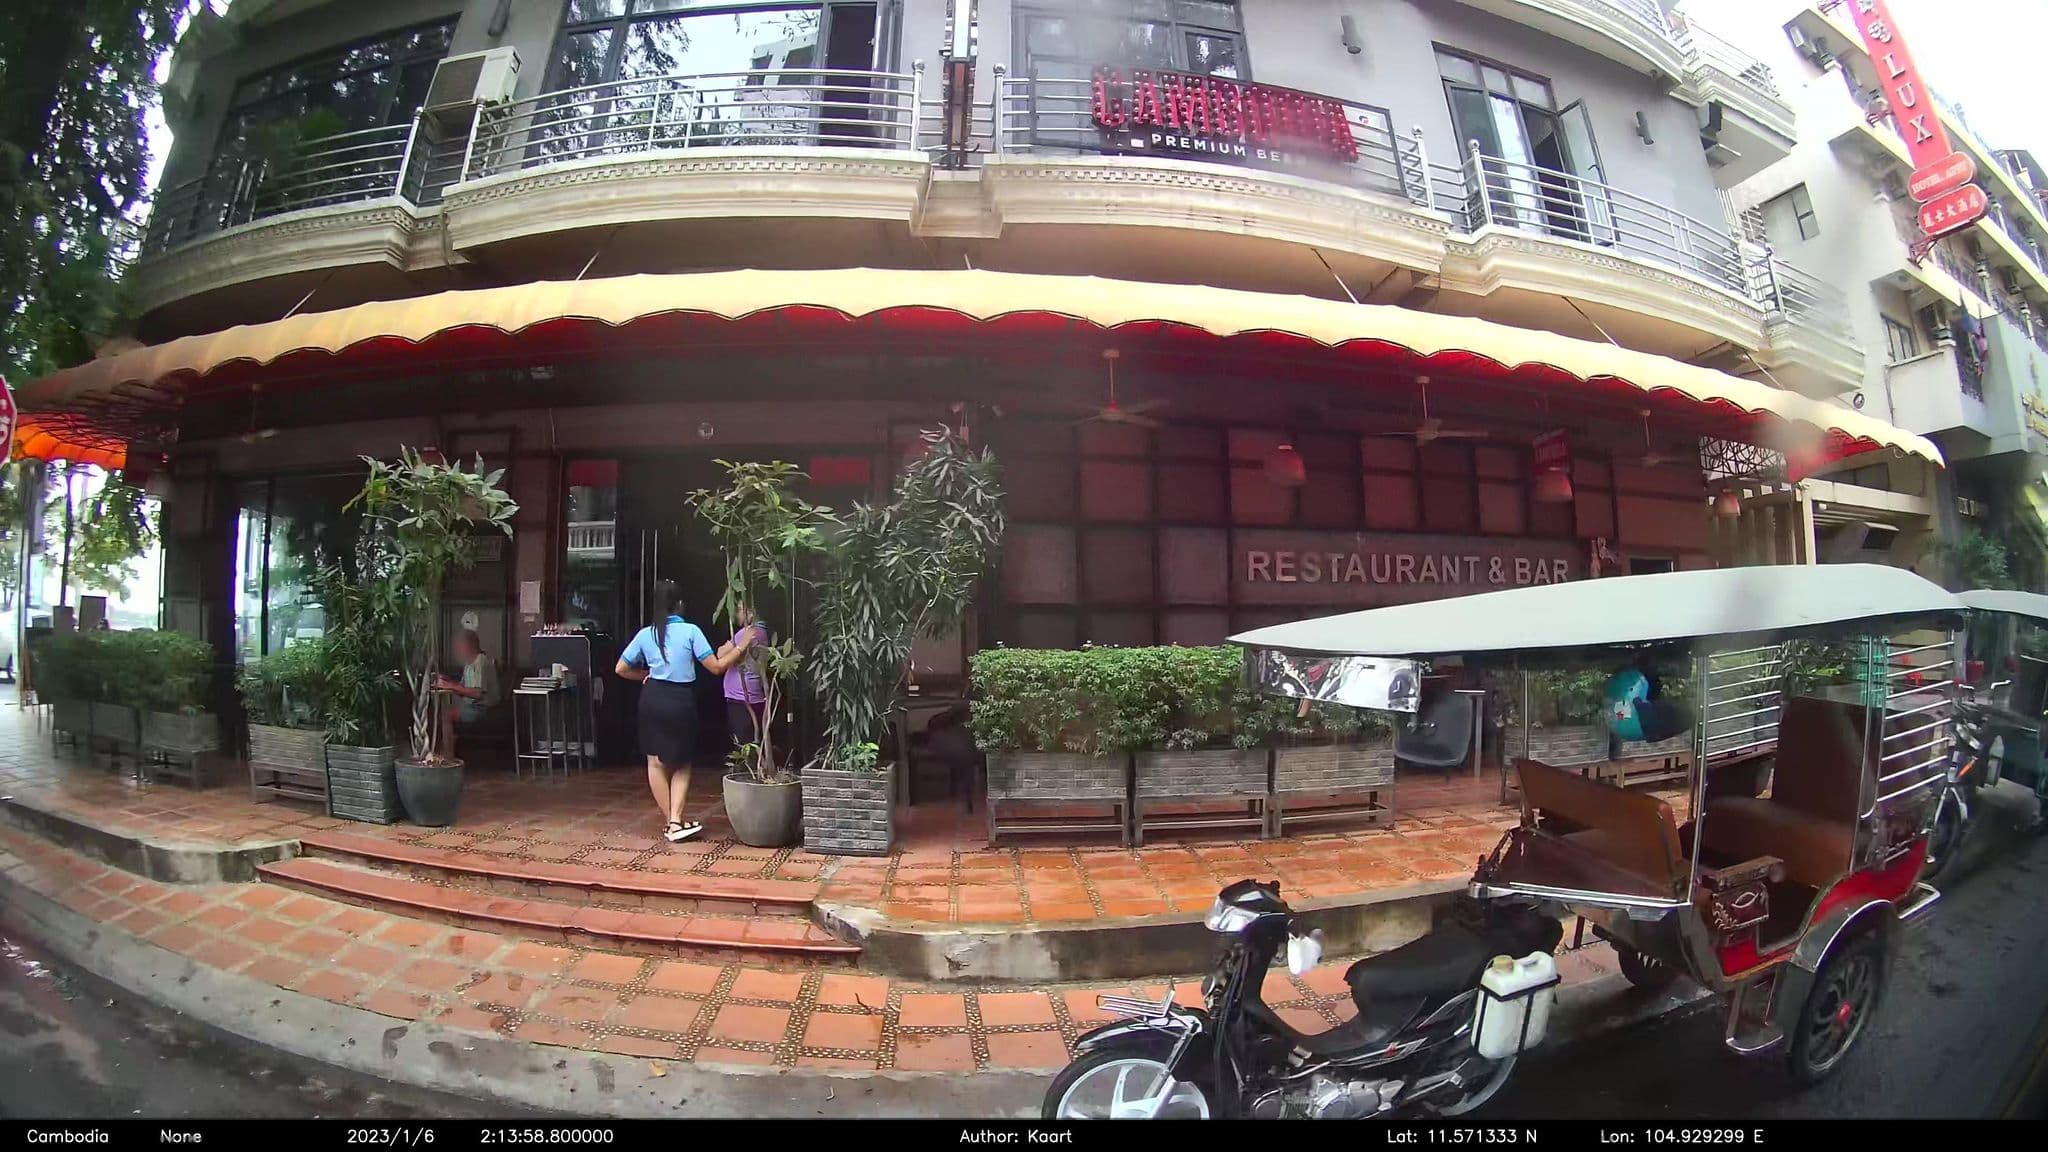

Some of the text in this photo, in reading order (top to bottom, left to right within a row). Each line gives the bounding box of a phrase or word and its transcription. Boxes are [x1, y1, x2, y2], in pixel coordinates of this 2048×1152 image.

[1090, 64, 1359, 162] CAMBOA
[1882, 54, 1933, 144] LUX
[1152, 132, 1247, 158] PREMIUM
[1247, 551, 1569, 584] RESTAURANT & BAR
